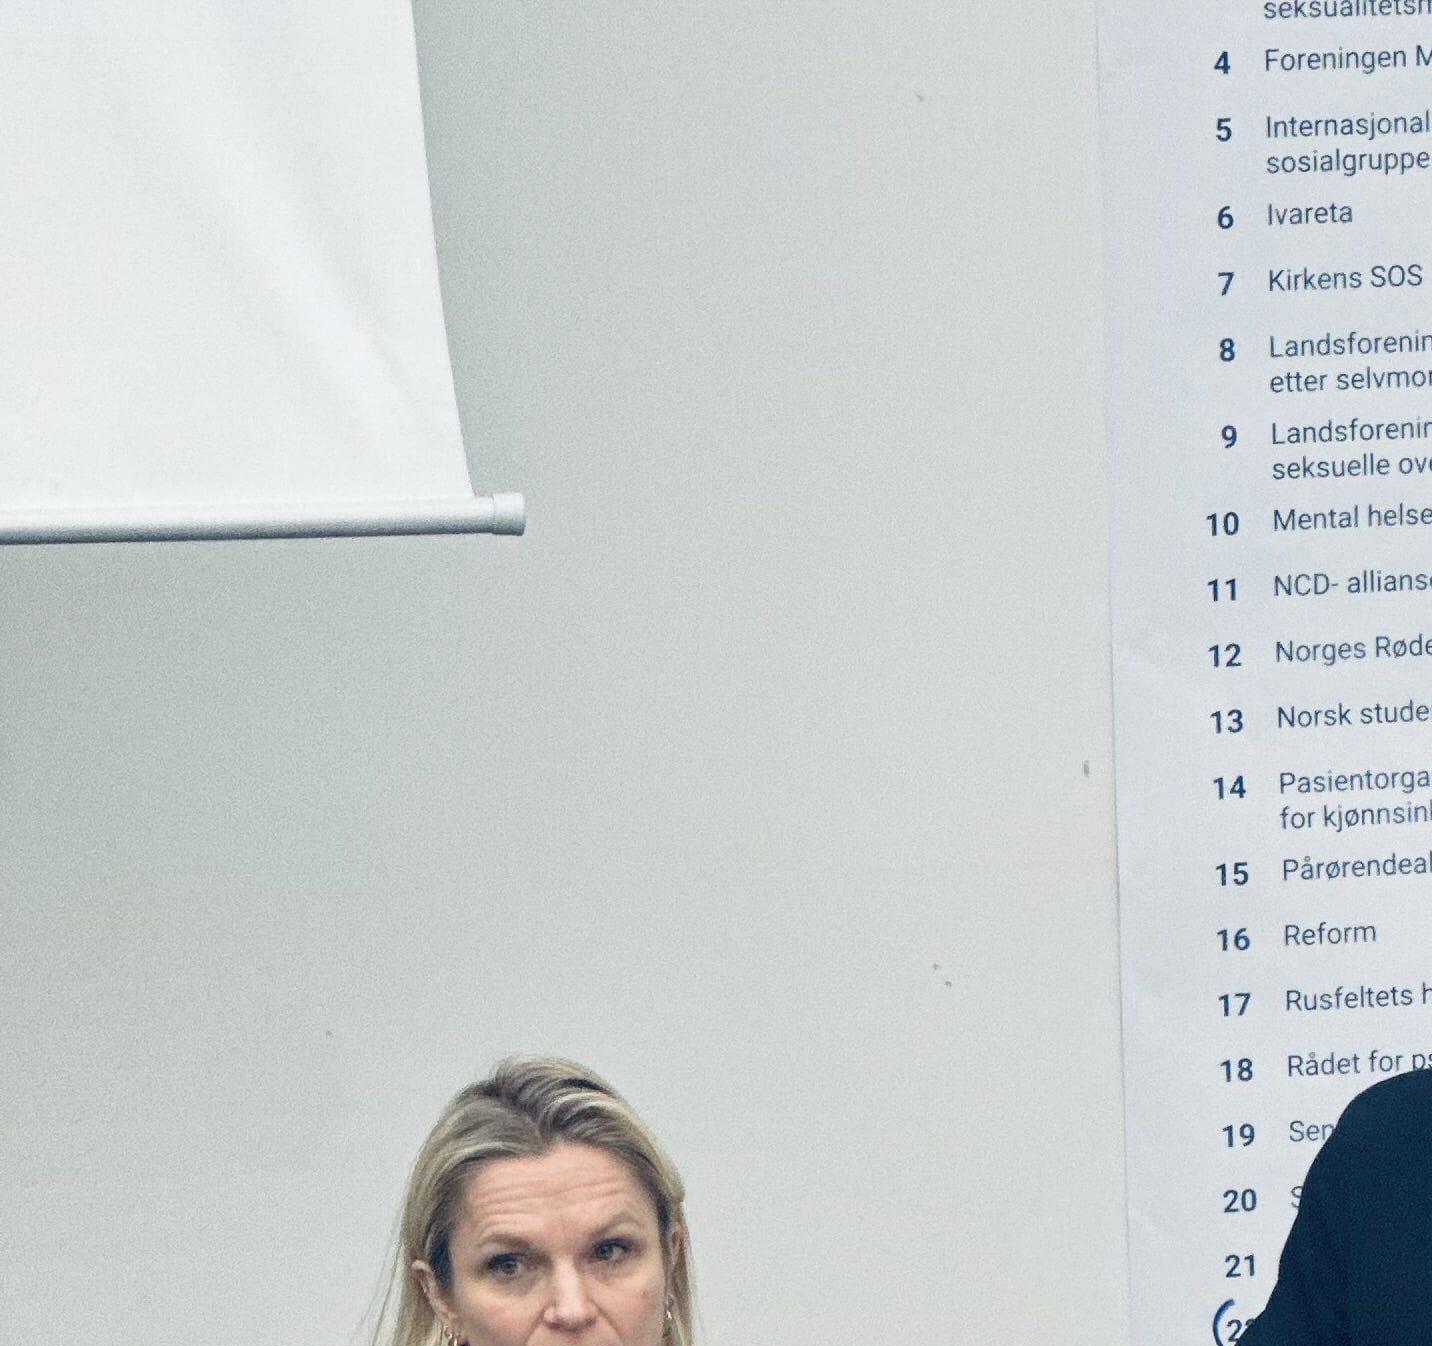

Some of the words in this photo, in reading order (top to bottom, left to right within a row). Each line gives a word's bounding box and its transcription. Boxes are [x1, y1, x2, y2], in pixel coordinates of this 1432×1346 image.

[1213, 51, 1232, 75] 4
[1265, 47, 1407, 75] Foreningen
[1215, 118, 1233, 142] 5
[1265, 109, 1430, 140] Internasjonal
[1266, 148, 1431, 177] sosialgruppe
[1217, 206, 1234, 229] 6
[1267, 203, 1353, 226] Ivareta
[1217, 272, 1235, 296] 7
[1268, 267, 1363, 292] Kirkens
[1370, 264, 1423, 288] SOS
[1218, 338, 1236, 362] 8
[1270, 372, 1328, 394] etter
[1220, 425, 1238, 449] 9
[1272, 453, 1391, 480] seksuelle
[1206, 512, 1239, 536] 10
[1273, 505, 1359, 531] Mental
[1207, 578, 1237, 602] 11
[1274, 573, 1339, 597] NCD-
[1208, 643, 1242, 669] 12
[1275, 640, 1366, 667] Norges
[1210, 709, 1244, 734] 13
[1277, 703, 1352, 729] Norsk
[1213, 775, 1246, 800] 14
[1280, 805, 1316, 830] for
[1215, 862, 1249, 887] 15
[1217, 928, 1250, 952] 16
[1284, 922, 1377, 947] Reform
[1218, 993, 1251, 1017] 17
[1286, 985, 1413, 1012] Rusfeltets
[1220, 1058, 1254, 1082] 18
[1288, 1051, 1361, 1077] Rådet
[1370, 1049, 1404, 1073] for
[1222, 1123, 1255, 1147] 19
[1289, 1120, 1335, 1143] Sen
[1223, 1188, 1257, 1213] 20
[1225, 1254, 1256, 1279] 21
